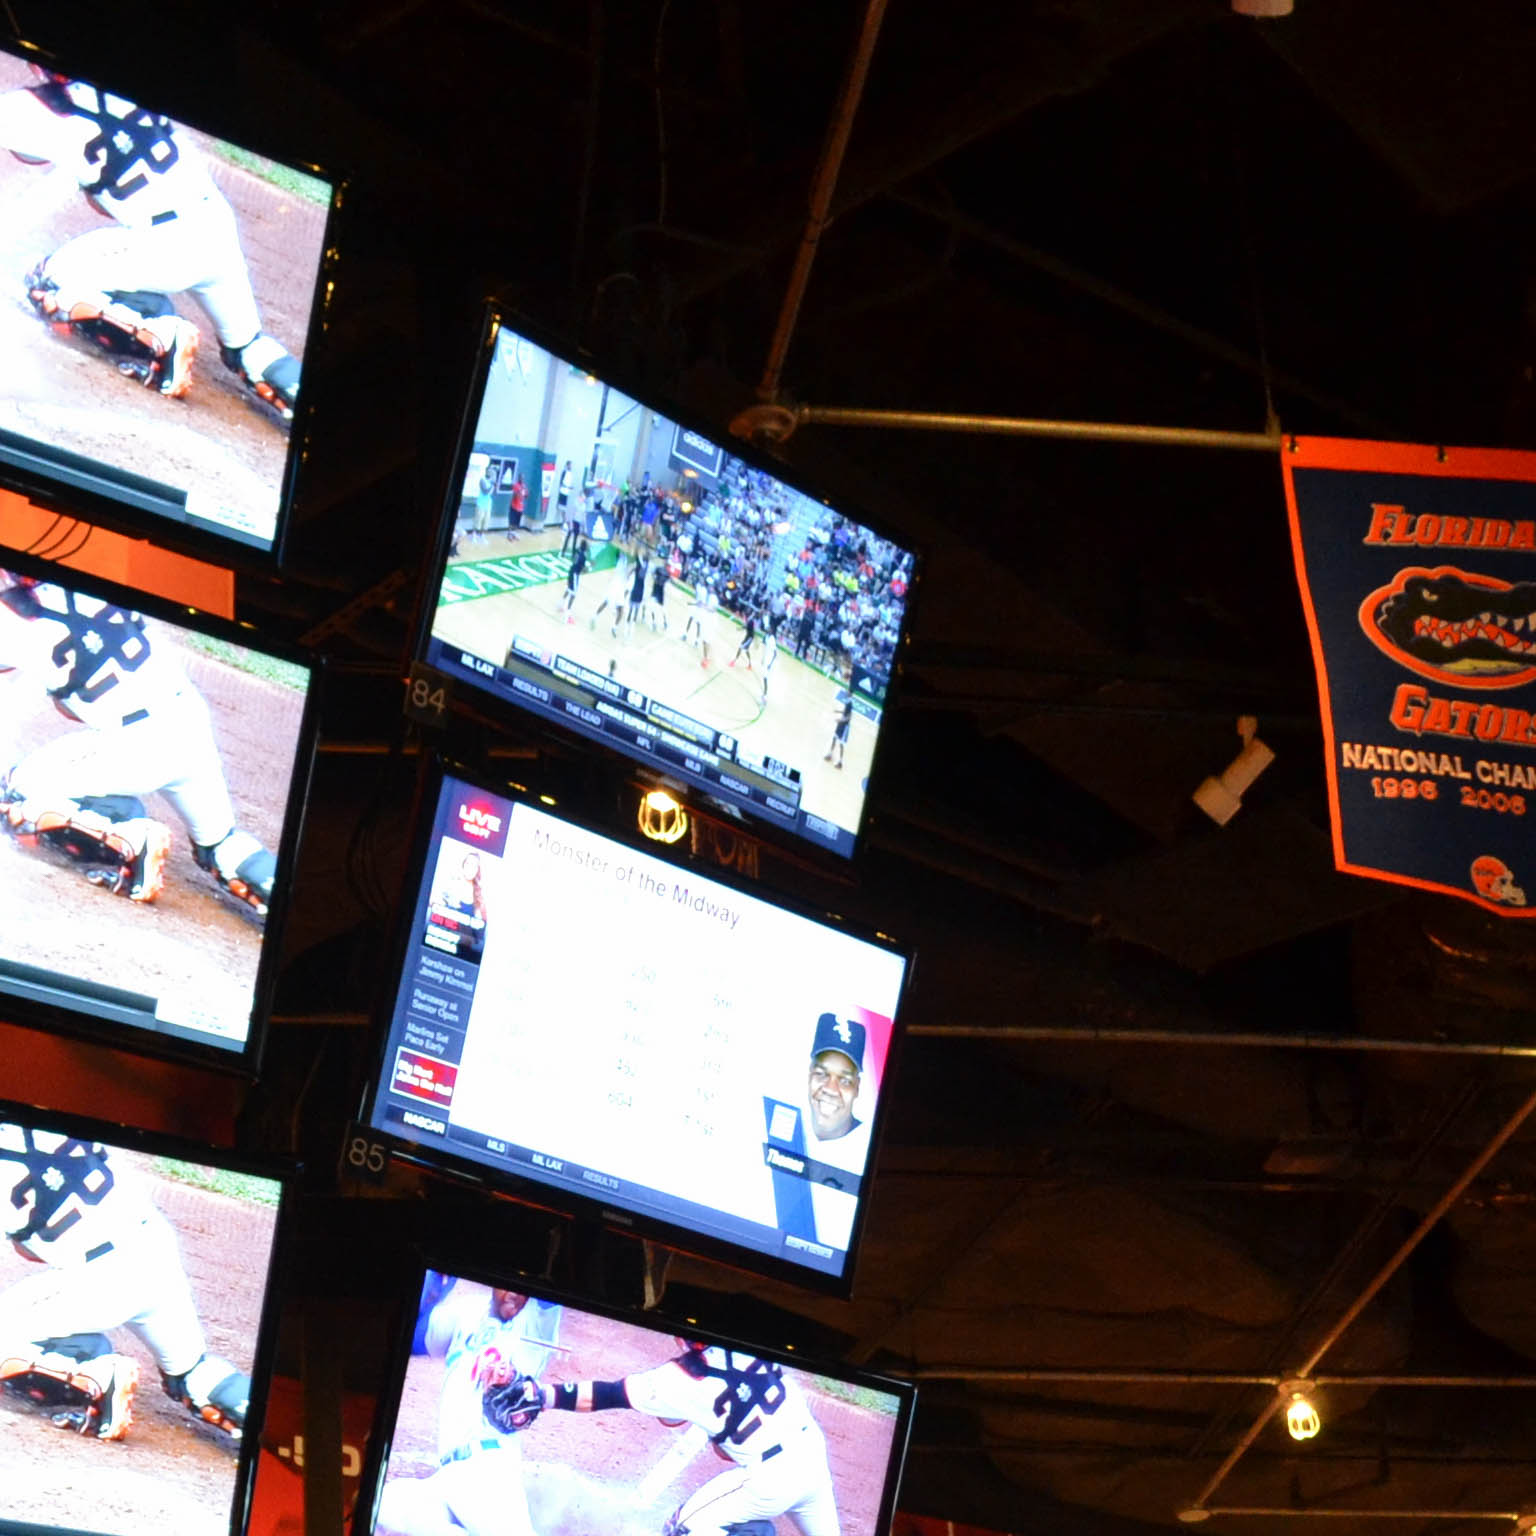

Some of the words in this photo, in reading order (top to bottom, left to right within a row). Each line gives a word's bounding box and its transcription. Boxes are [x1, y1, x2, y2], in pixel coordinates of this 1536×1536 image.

[411, 683, 446, 714] 84
[566, 700, 580, 716] THE
[1342, 743, 1471, 780] NATIONAL
[1371, 776, 1437, 801] 1996
[459, 804, 501, 832] LIVE
[533, 828, 609, 873] Monster
[616, 866, 634, 881] of
[639, 872, 666, 897] the
[672, 884, 741, 931] Midway
[403, 1111, 445, 1135] NASCAR
[349, 1138, 384, 1172] 85
[545, 1157, 563, 1172] LAX
[582, 1170, 619, 1190] RESULTS
